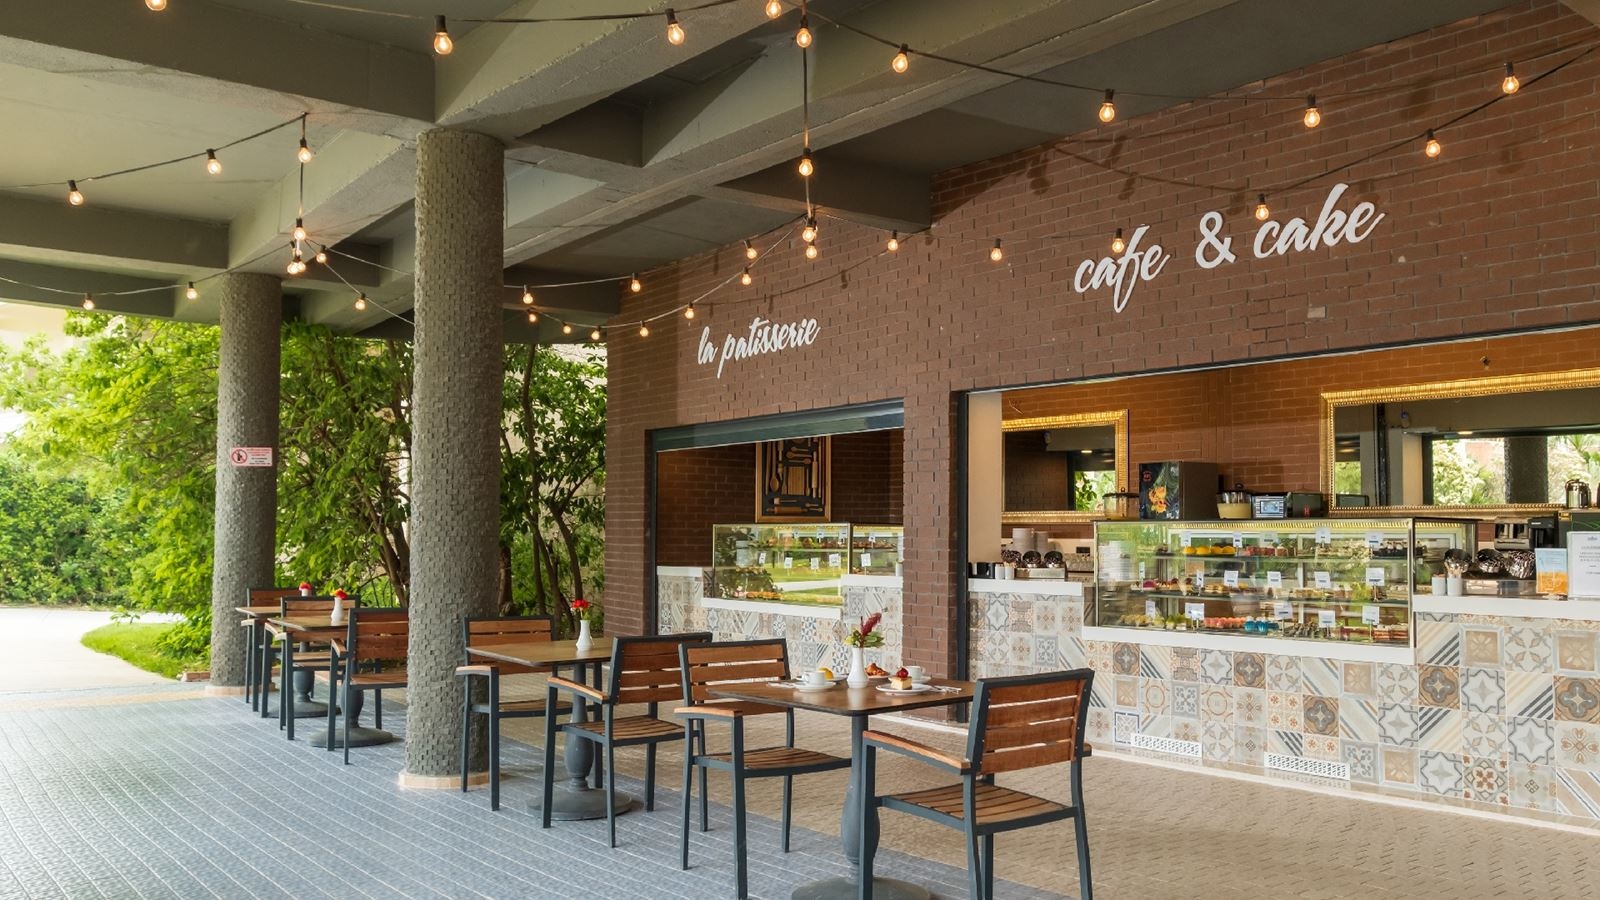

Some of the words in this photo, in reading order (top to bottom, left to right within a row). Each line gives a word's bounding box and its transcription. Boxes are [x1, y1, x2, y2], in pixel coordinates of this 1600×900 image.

[1074, 224, 1170, 313] cafe
[1195, 211, 1236, 269] &
[1253, 183, 1385, 259] cake
[698, 326, 719, 365] la
[717, 317, 821, 379] patisserie
